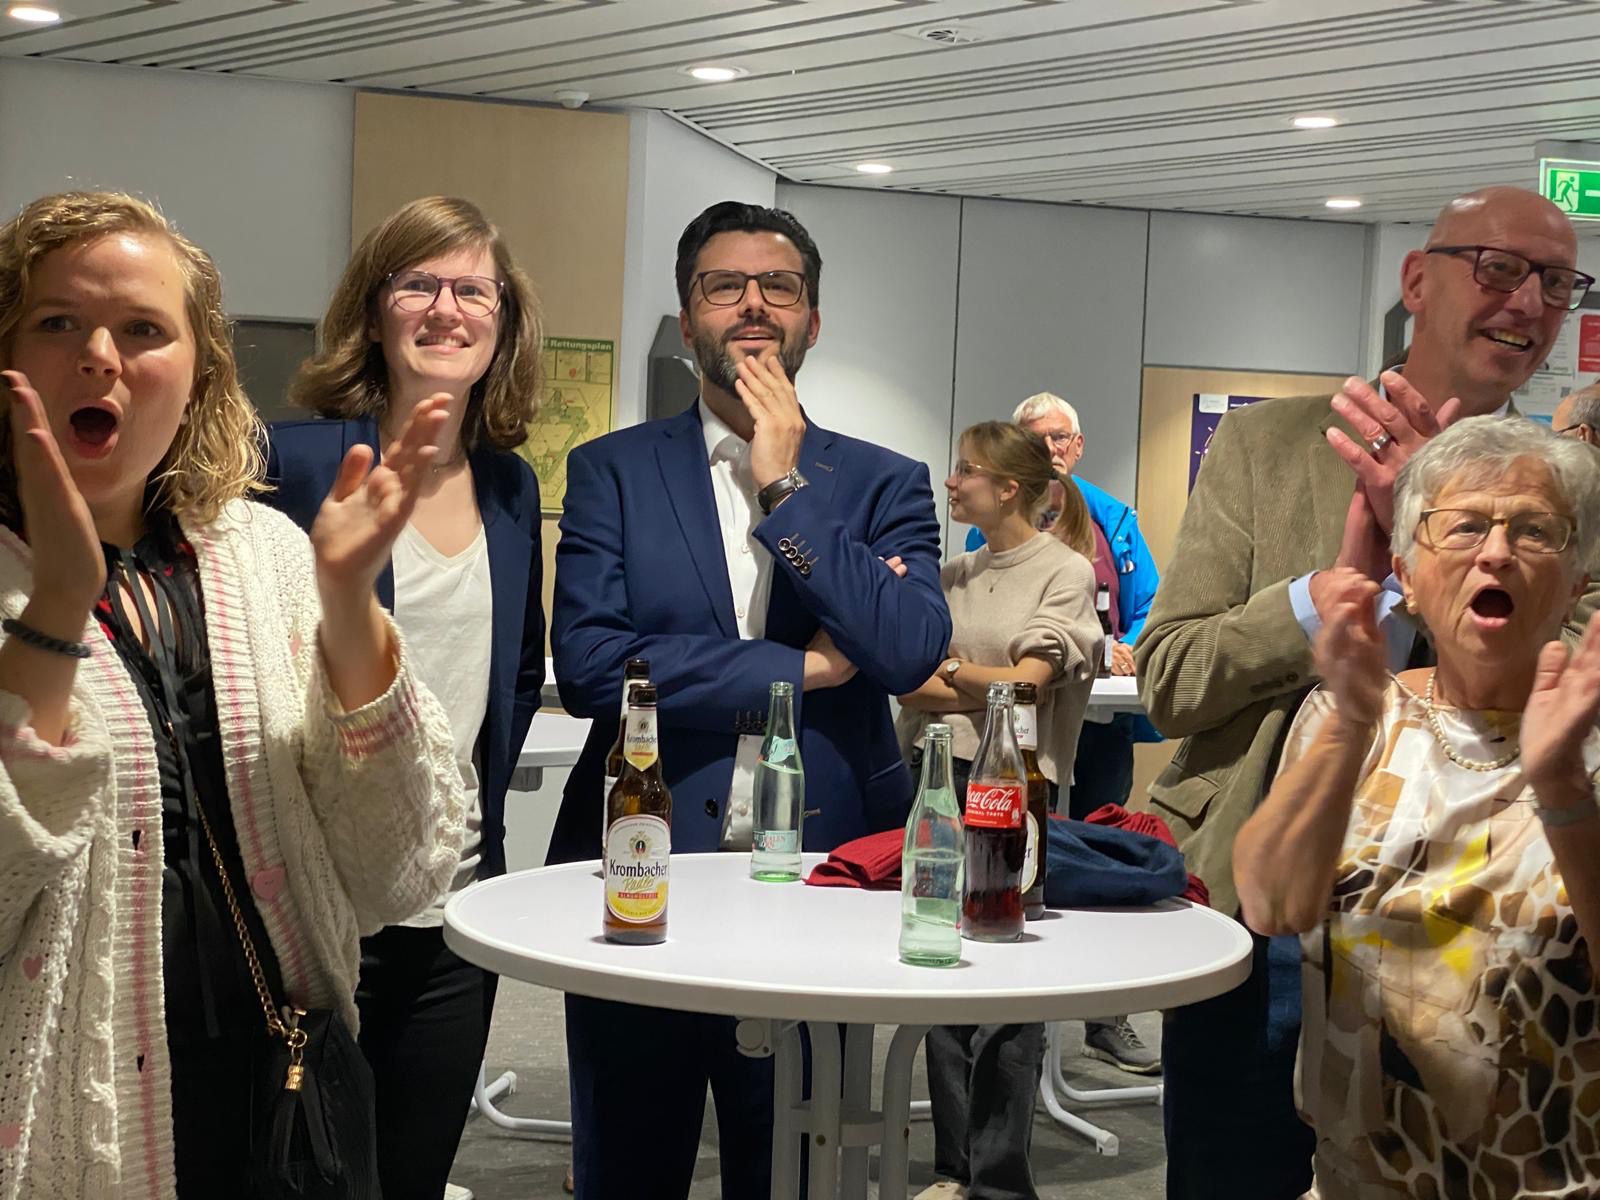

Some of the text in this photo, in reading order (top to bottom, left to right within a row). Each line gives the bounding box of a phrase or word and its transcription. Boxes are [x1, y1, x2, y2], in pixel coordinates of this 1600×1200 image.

[550, 340, 612, 351] Rettungsplan
[967, 785, 1016, 811] oca-Cola
[609, 859, 668, 877] Krombacher
